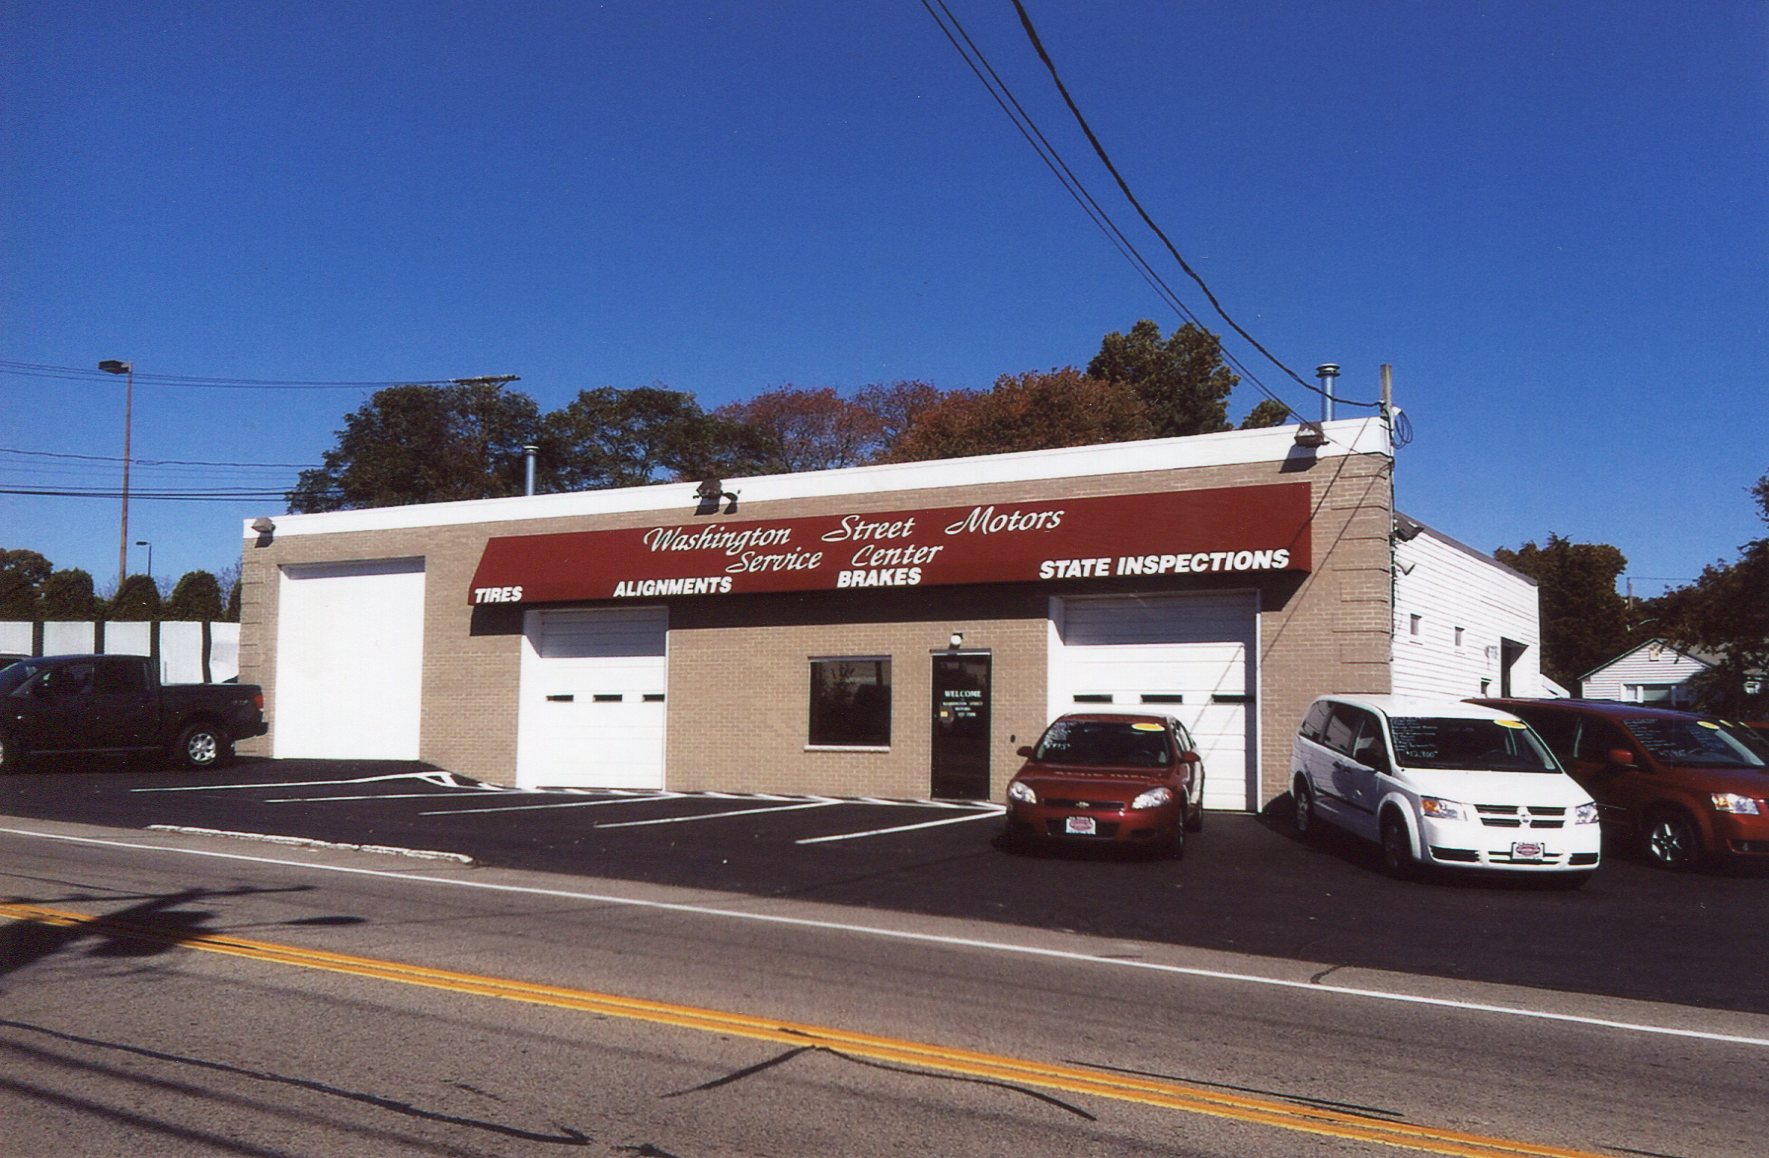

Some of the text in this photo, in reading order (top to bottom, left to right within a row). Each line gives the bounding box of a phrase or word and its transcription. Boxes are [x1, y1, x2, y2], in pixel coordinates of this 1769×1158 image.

[643, 506, 1064, 556] Washington Street Motors
[726, 544, 944, 574] Service Center
[1039, 549, 1290, 580] STATE INSPECTIONS
[612, 576, 733, 598] ALIGNMENTS
[836, 566, 922, 588] BRAKES
[474, 585, 523, 604] TIRES
